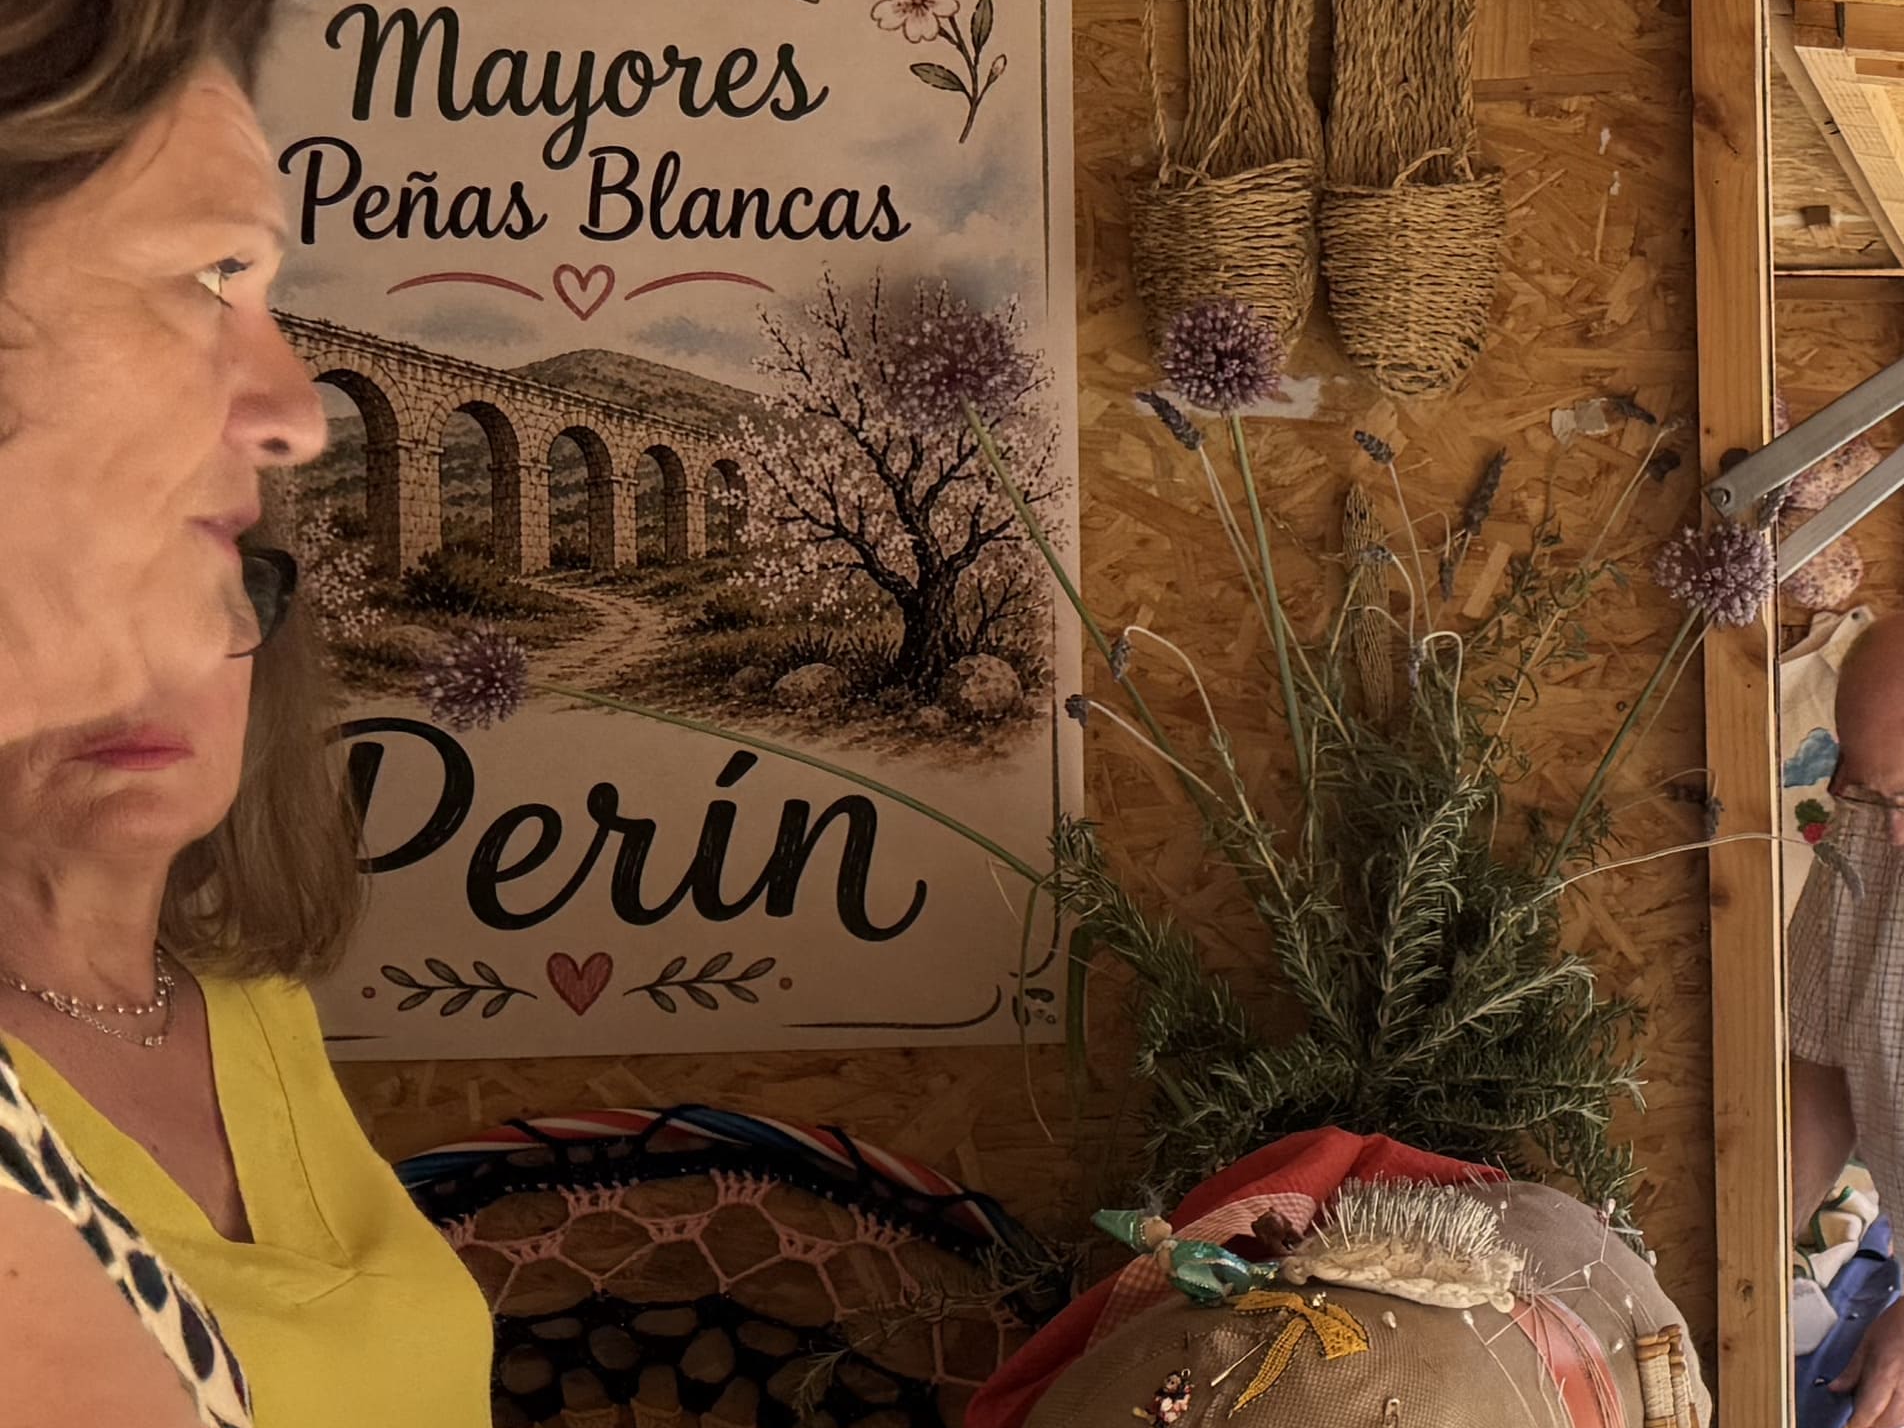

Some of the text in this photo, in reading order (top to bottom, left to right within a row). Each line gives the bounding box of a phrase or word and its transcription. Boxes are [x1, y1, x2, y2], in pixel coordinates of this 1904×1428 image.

[325, 4, 829, 170] Mayores
[279, 136, 911, 244] Peñas Blancas
[326, 717, 927, 942] Perín
